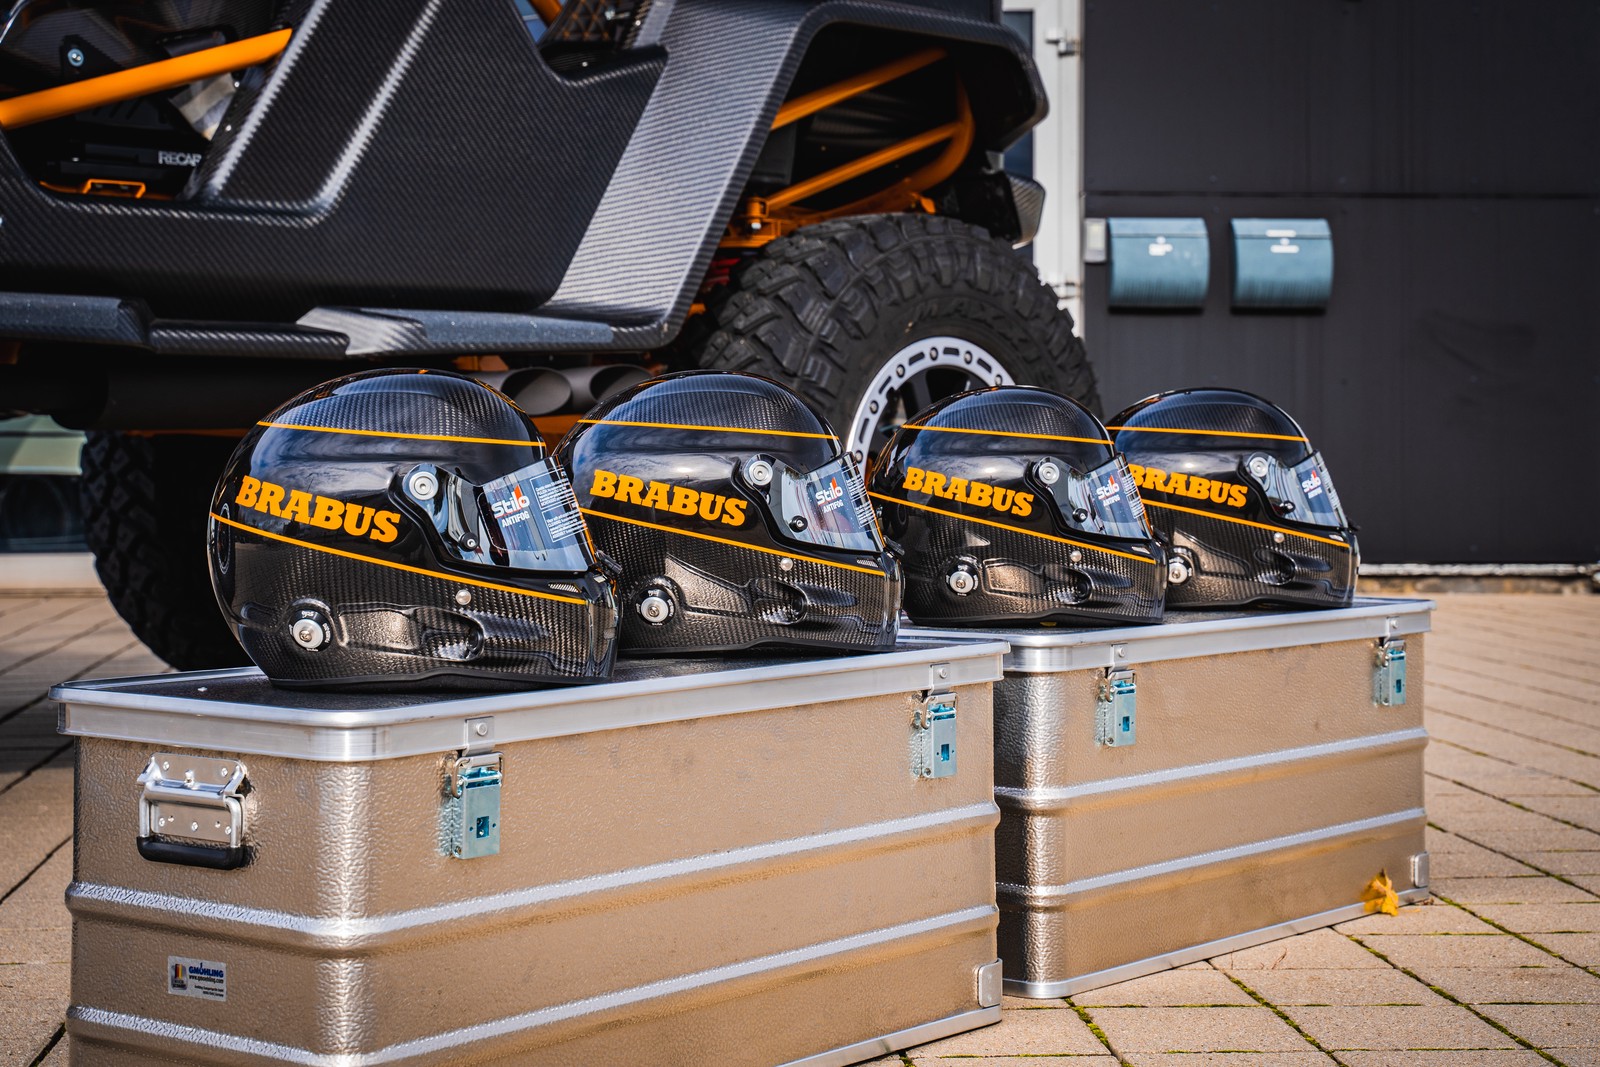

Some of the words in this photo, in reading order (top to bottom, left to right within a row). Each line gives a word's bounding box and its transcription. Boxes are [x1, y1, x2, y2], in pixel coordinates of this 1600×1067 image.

[491, 485, 530, 519] Stilo
[590, 470, 748, 528] BRABUS
[815, 477, 843, 507] Stilo
[903, 467, 1035, 518] BRABUS
[1128, 464, 1249, 508] BRABUS
[235, 476, 401, 543] BRABUS
[502, 511, 530, 528] ANTIFOG
[822, 500, 844, 514] ANTIFOG
